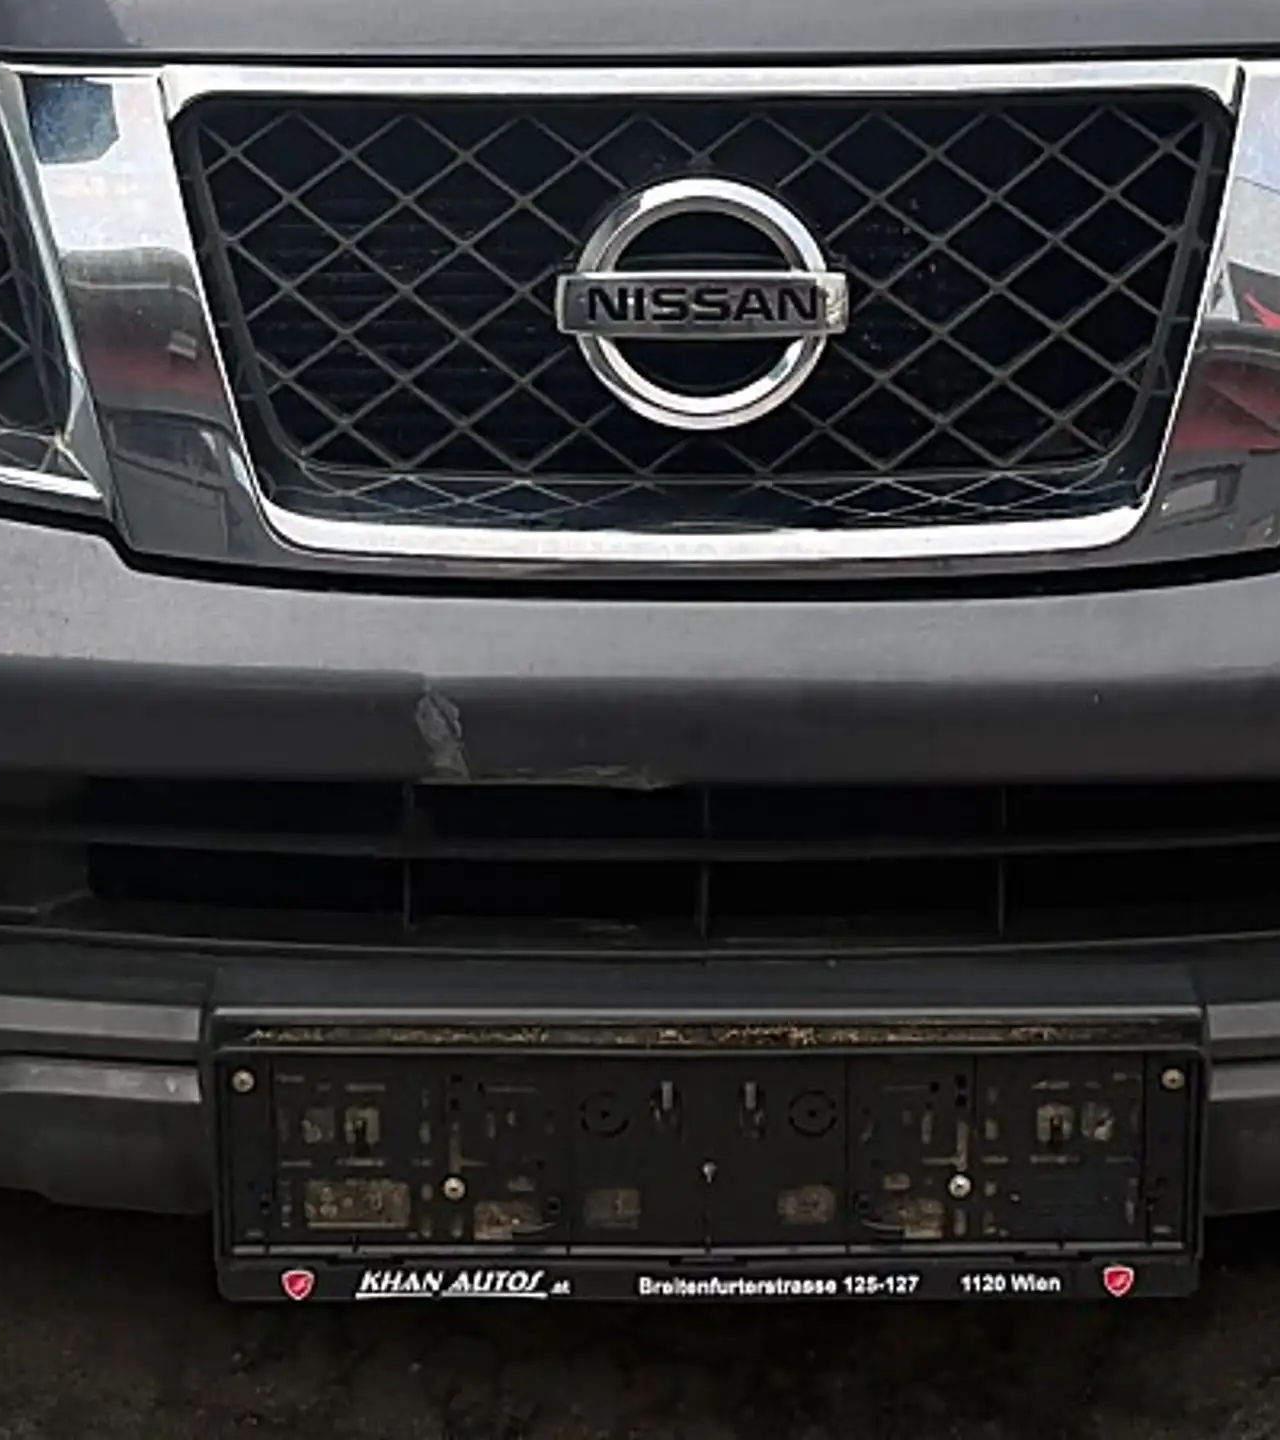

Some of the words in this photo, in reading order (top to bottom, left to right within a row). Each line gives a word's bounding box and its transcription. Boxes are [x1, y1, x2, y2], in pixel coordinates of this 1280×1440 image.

[587, 286, 818, 322] NISSAN
[359, 1270, 443, 1291] KHAN
[448, 1270, 544, 1292] AUTOS
[639, 1276, 838, 1297] Breitenfurterstrasse
[843, 1274, 920, 1295] 125-127
[960, 1273, 1006, 1292] 1120
[1010, 1273, 1061, 1292] Wien
